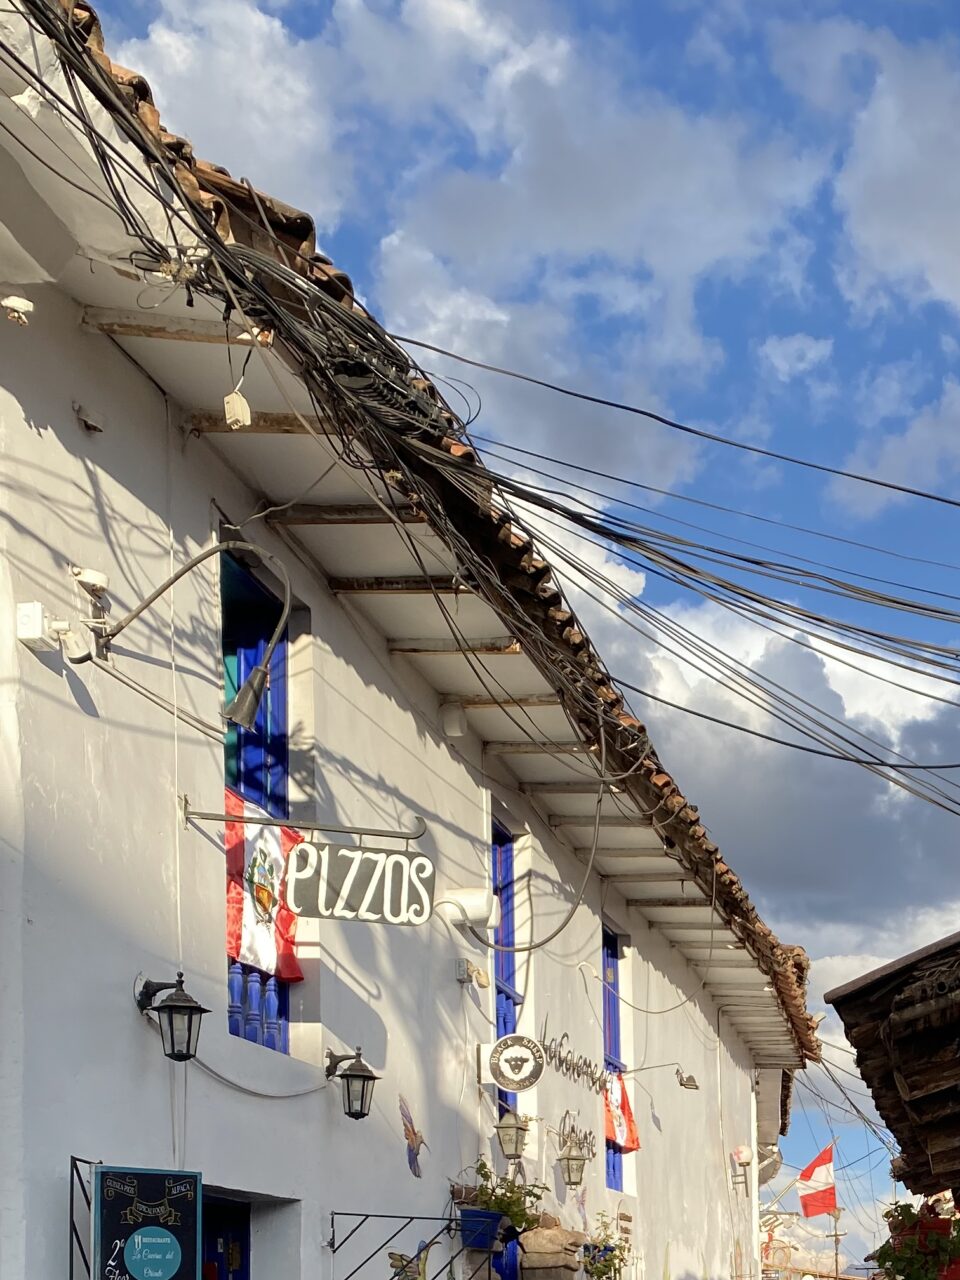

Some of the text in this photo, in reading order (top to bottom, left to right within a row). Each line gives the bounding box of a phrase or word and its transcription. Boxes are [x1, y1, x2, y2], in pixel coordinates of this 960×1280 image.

[491, 1037, 543, 1064] BLACK SHEEP
[171, 1183, 190, 1195] ALPACA
